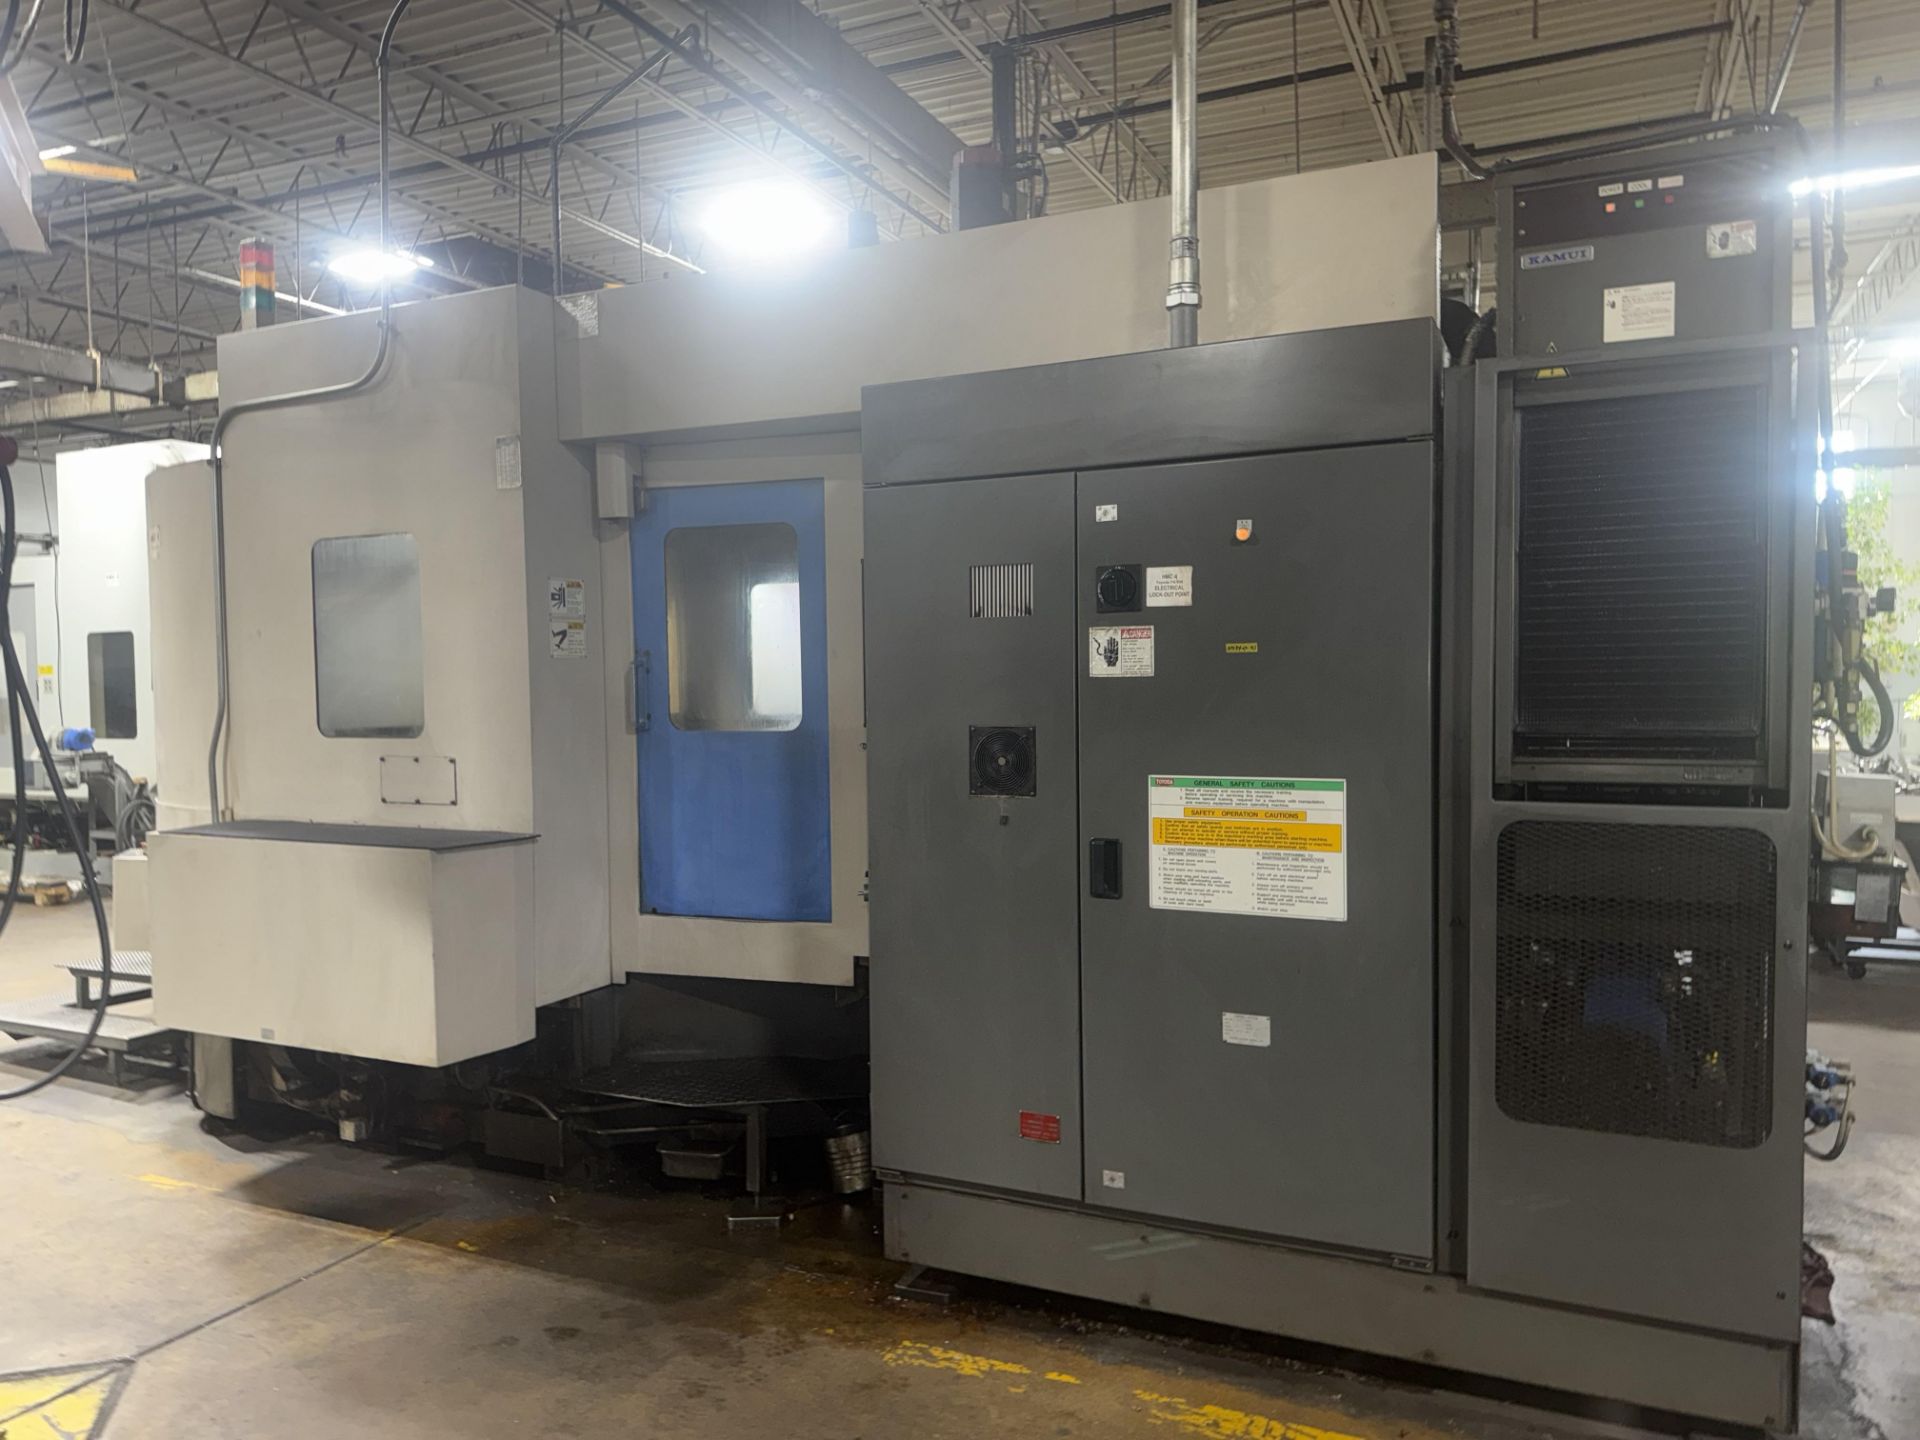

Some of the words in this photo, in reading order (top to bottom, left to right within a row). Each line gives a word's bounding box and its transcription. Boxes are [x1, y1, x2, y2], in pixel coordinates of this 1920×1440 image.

[1528, 250, 1586, 265] KAMUI
[1193, 779, 1223, 787] GENERAL
[1230, 780, 1255, 788] SAFETY
[1221, 810, 1259, 818] OPERATION
[1264, 812, 1299, 820] CAUTIONS
